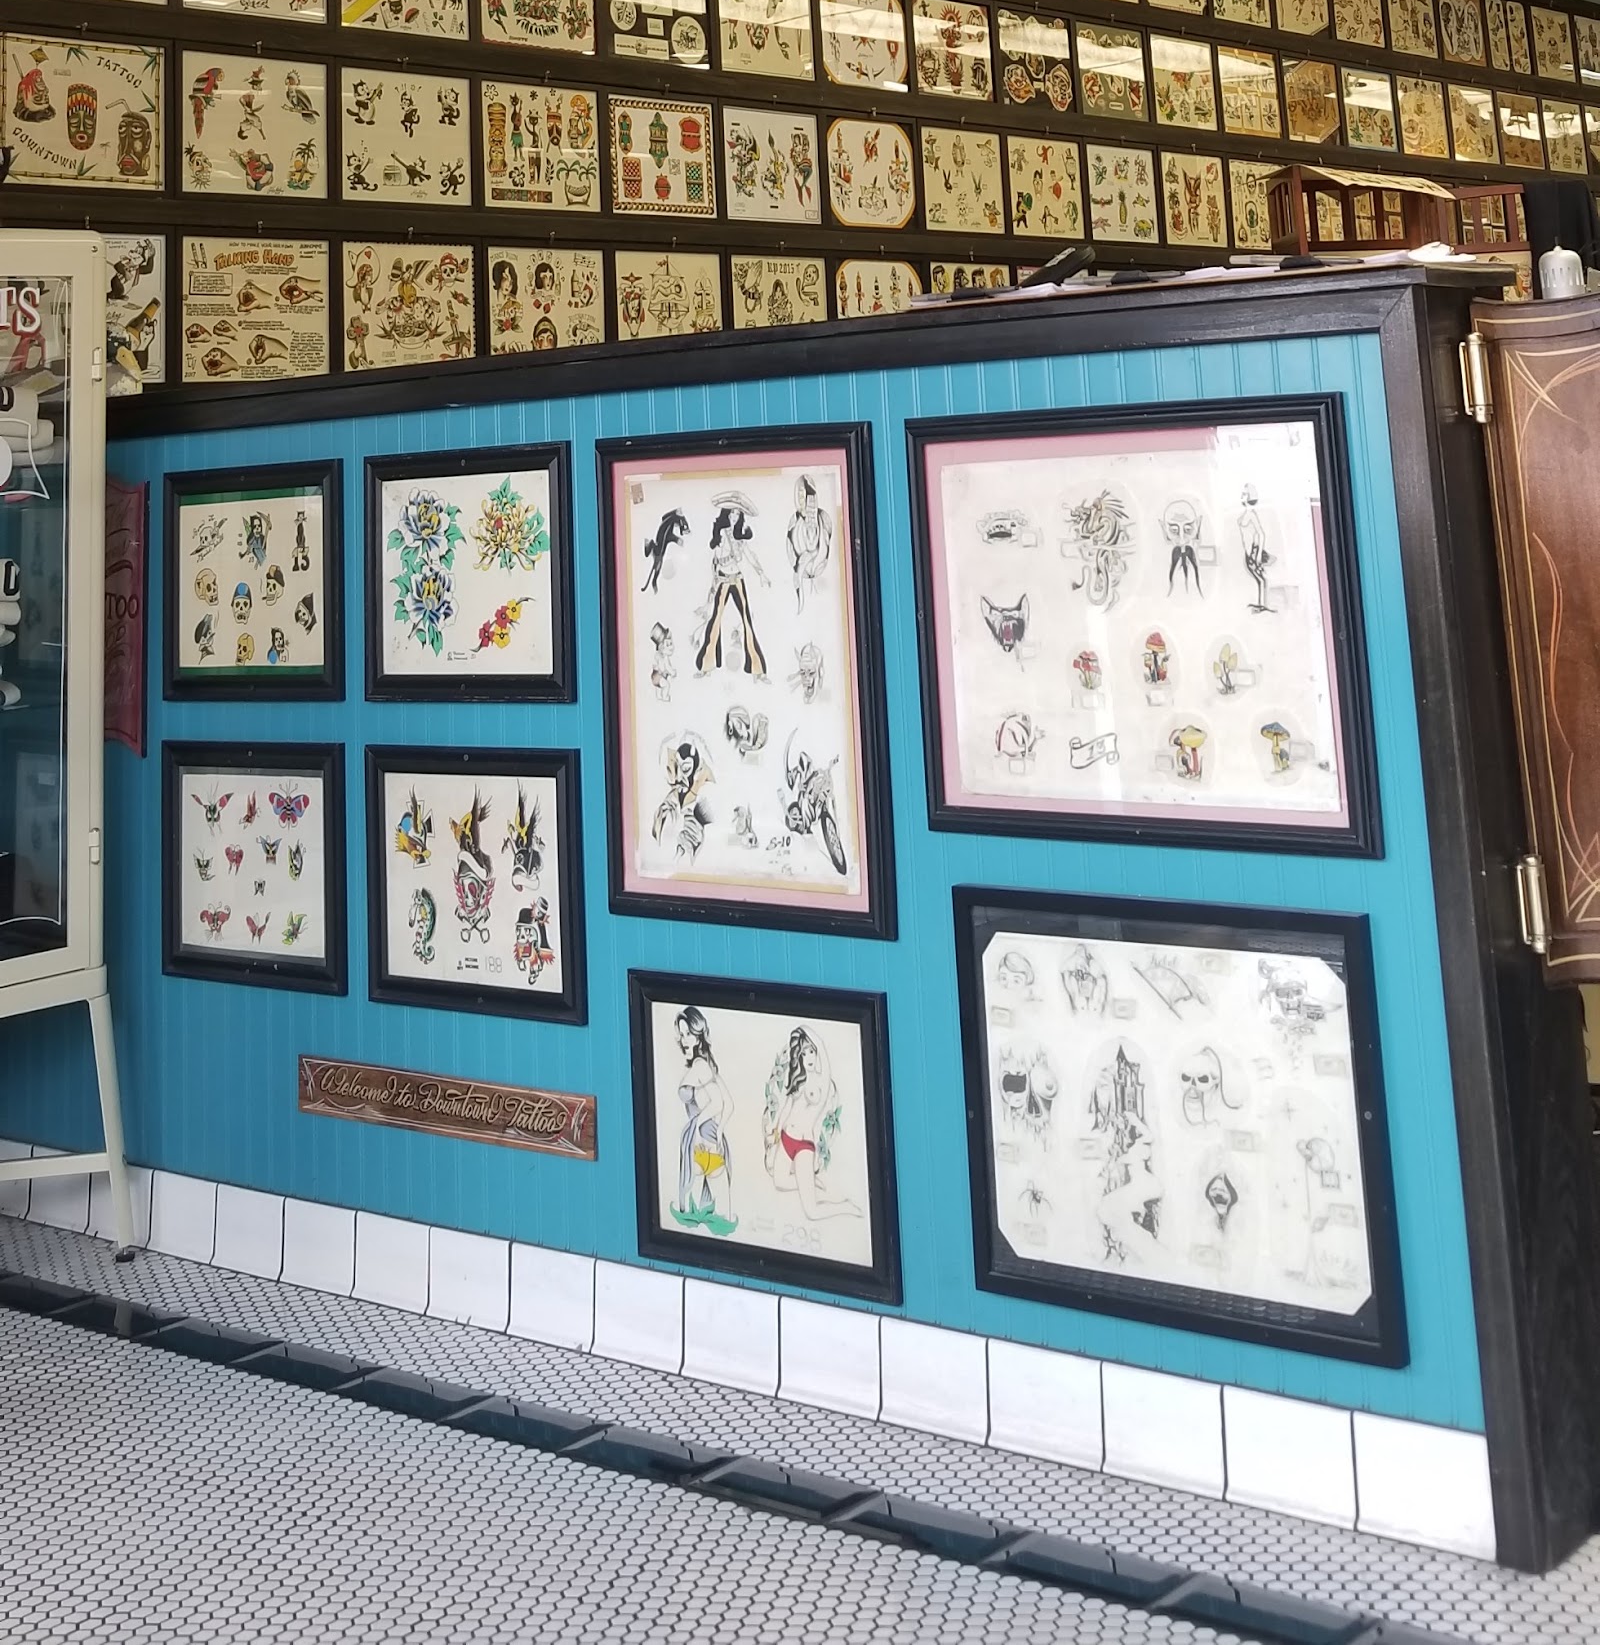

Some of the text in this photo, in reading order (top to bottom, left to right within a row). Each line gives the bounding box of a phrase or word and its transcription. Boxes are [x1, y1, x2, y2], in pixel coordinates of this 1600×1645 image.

[96, 55, 143, 89] TATTOO
[12, 126, 78, 170] DOWNTOWN
[214, 250, 260, 271] TALKING
[263, 249, 295, 266] HAND
[779, 262, 795, 274] 2015
[292, 548, 310, 572] 13
[106, 593, 139, 620] TOO
[320, 1067, 567, 1134] Welcome to Downtown Tattoo
[782, 1223, 822, 1253] 298
